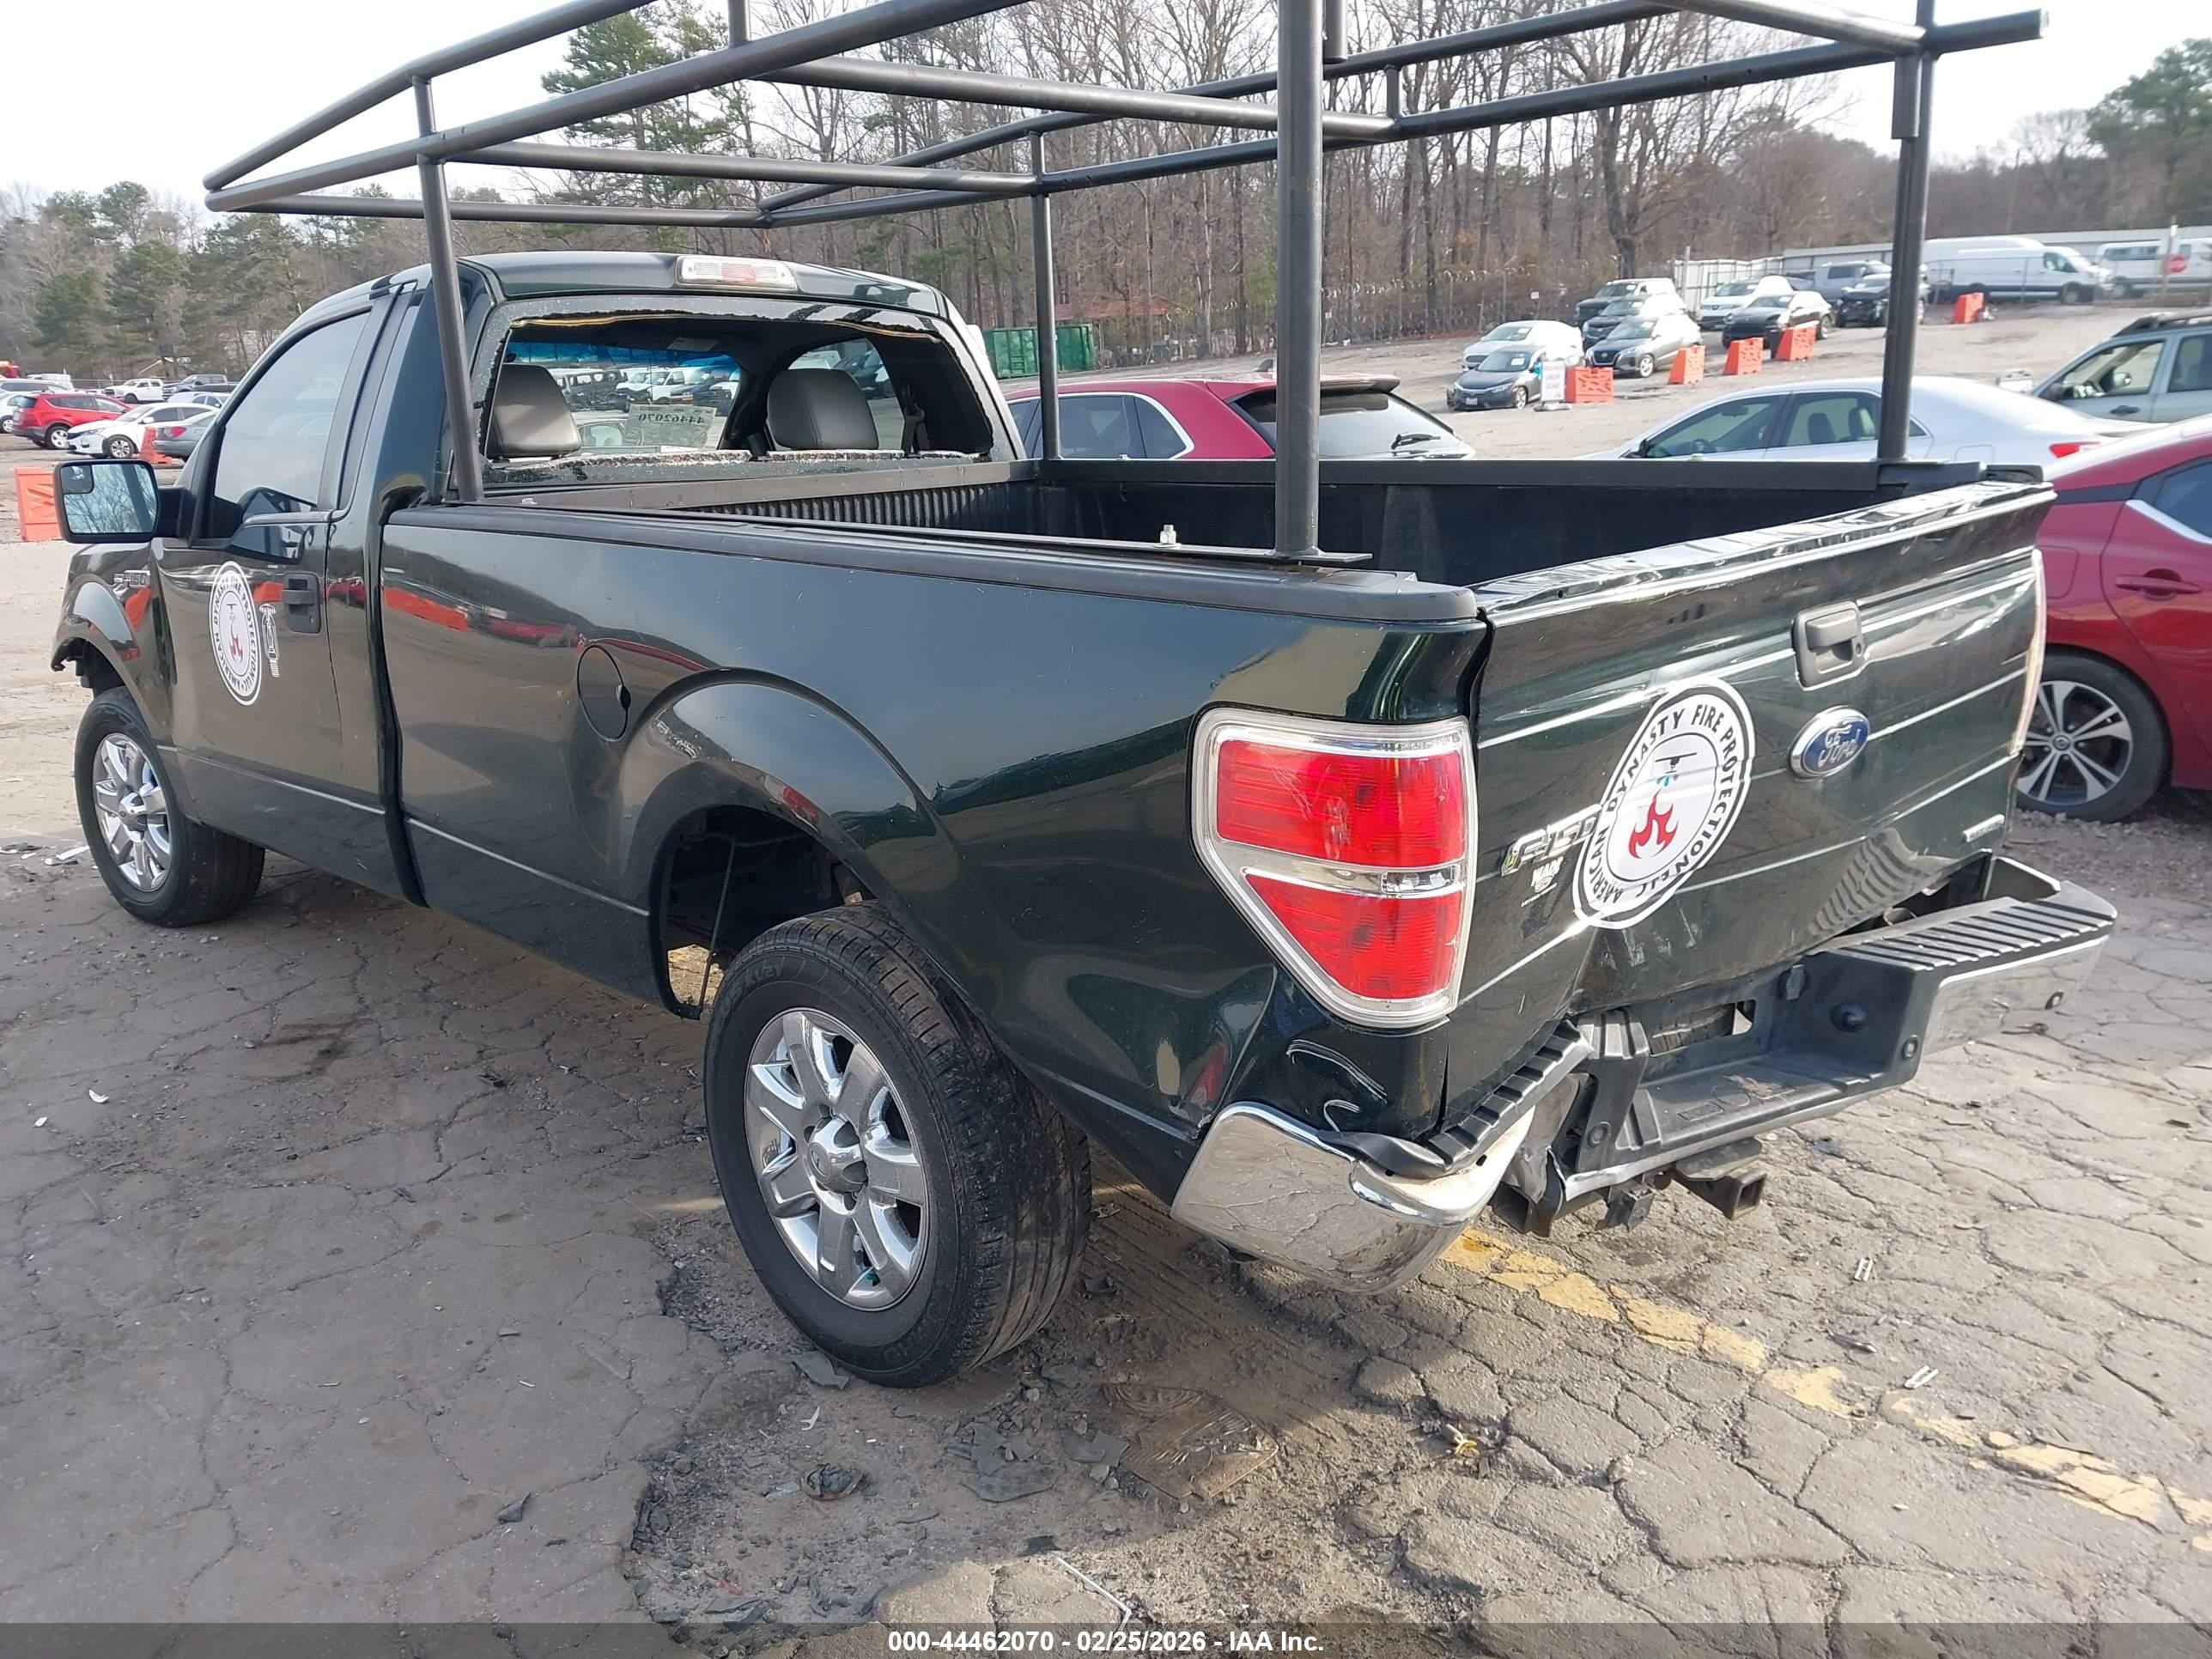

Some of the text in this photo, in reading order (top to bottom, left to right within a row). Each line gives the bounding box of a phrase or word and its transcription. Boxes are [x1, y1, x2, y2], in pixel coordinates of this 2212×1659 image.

[241, 592, 257, 682] PROTECTION
[1606, 708, 1686, 812] DYNASTY
[1690, 704, 1725, 733] FIRE
[1817, 723, 1862, 769] Ford
[1674, 726, 1738, 874] PROTECTION
[1589, 825, 1625, 903] AMERICAN
